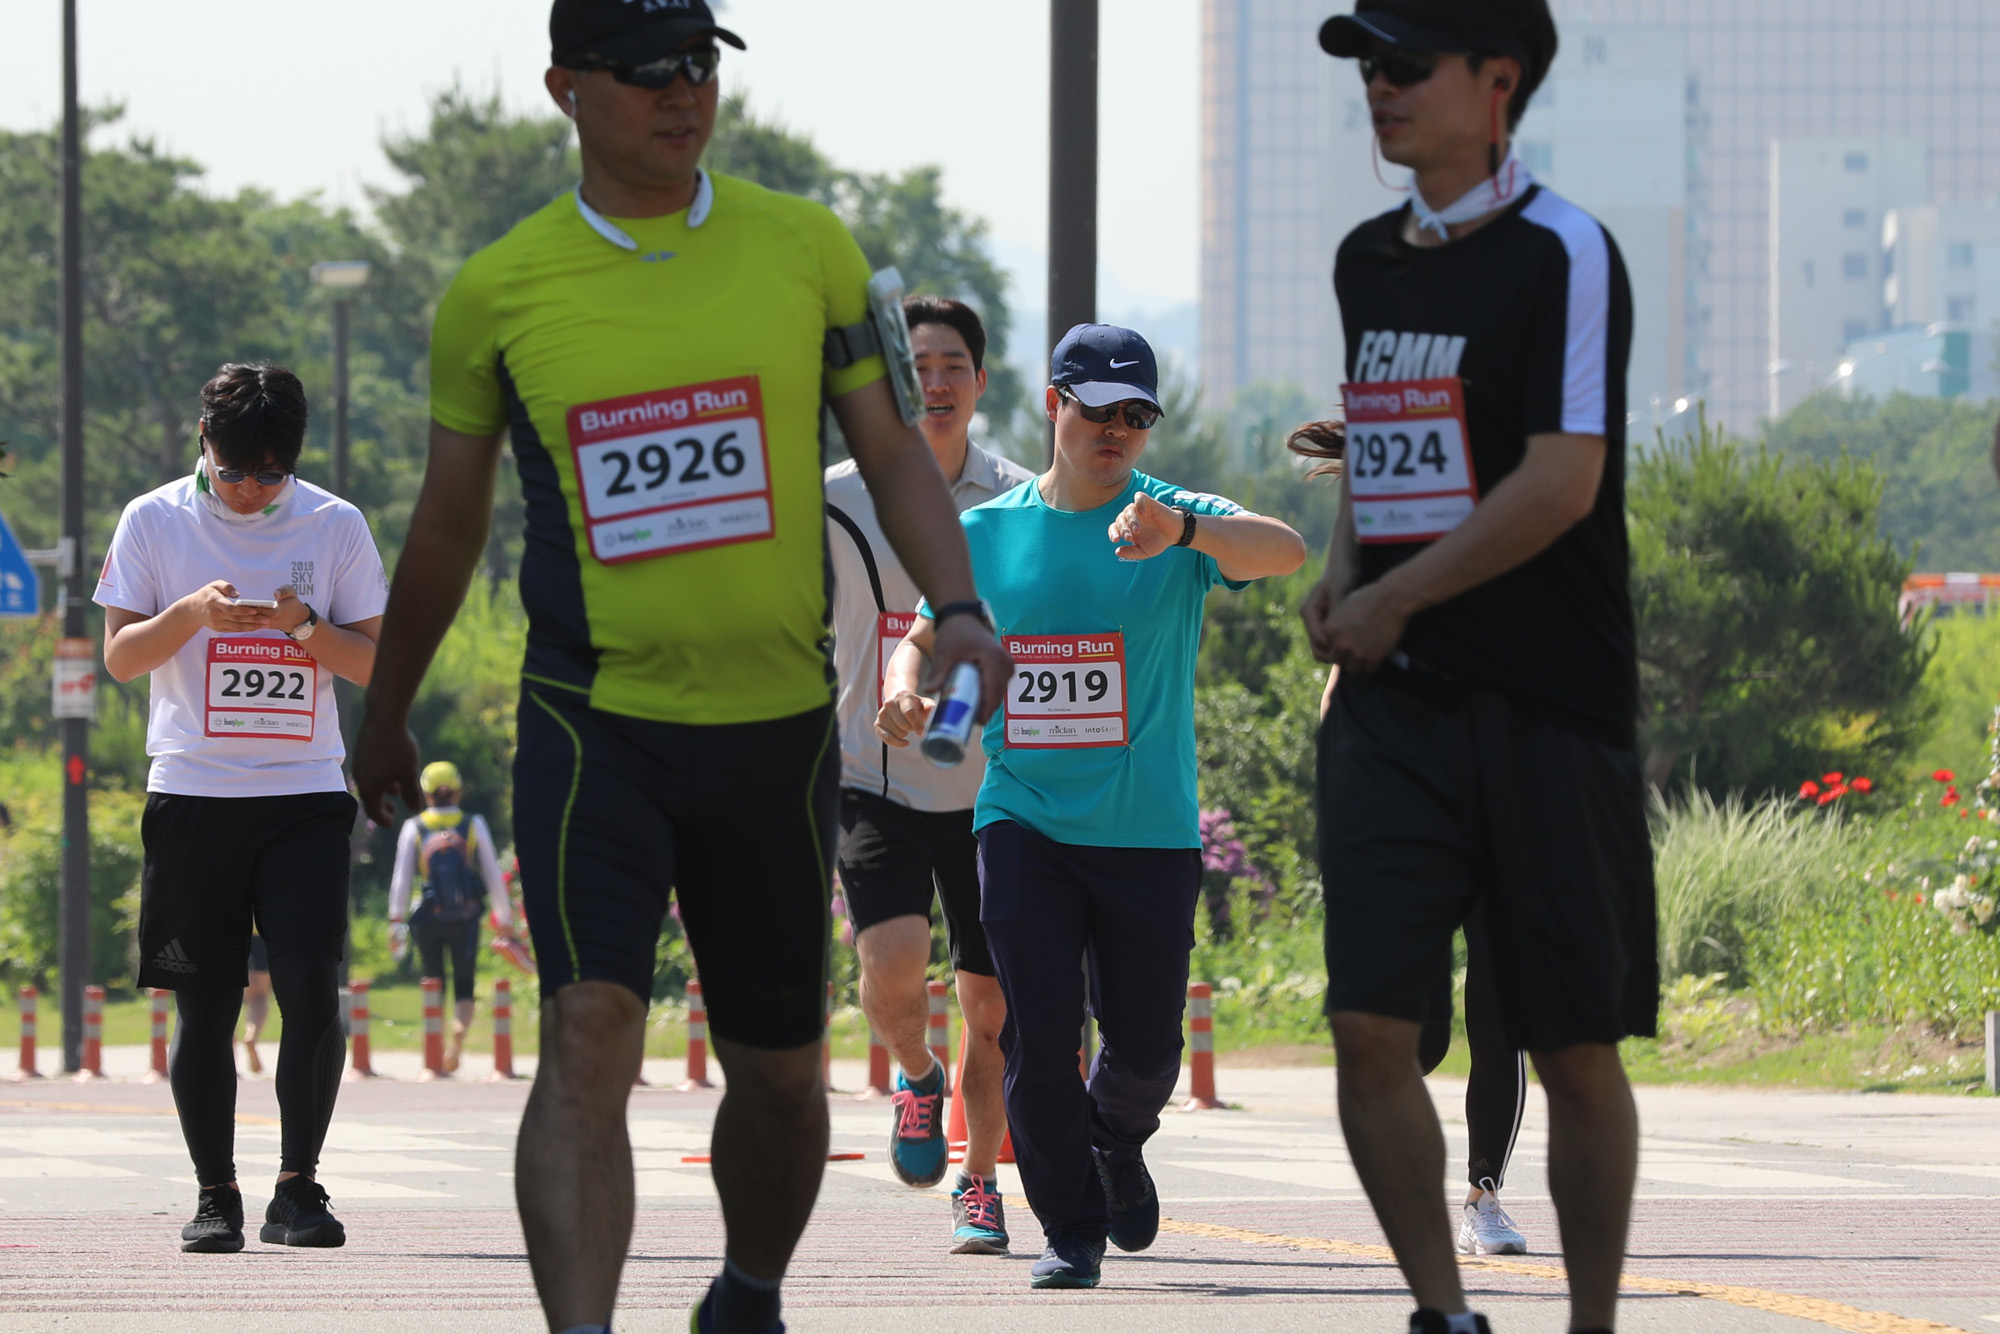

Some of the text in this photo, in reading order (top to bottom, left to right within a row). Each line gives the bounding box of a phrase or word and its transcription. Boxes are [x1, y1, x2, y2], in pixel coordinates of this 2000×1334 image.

[1353, 330, 1467, 381] FCMM
[1404, 388, 1451, 407] Run
[580, 398, 689, 432] Burning
[693, 389, 748, 411] Run
[601, 430, 745, 498] 2926
[1353, 430, 1447, 477] 2924
[291, 561, 314, 571] 2018
[291, 571, 314, 584] SKY
[216, 643, 280, 659] Burning
[1010, 640, 1114, 657] Burning Run
[221, 669, 305, 700] 2922
[1018, 670, 1108, 703] 2919
[152, 958, 198, 974] adidas
